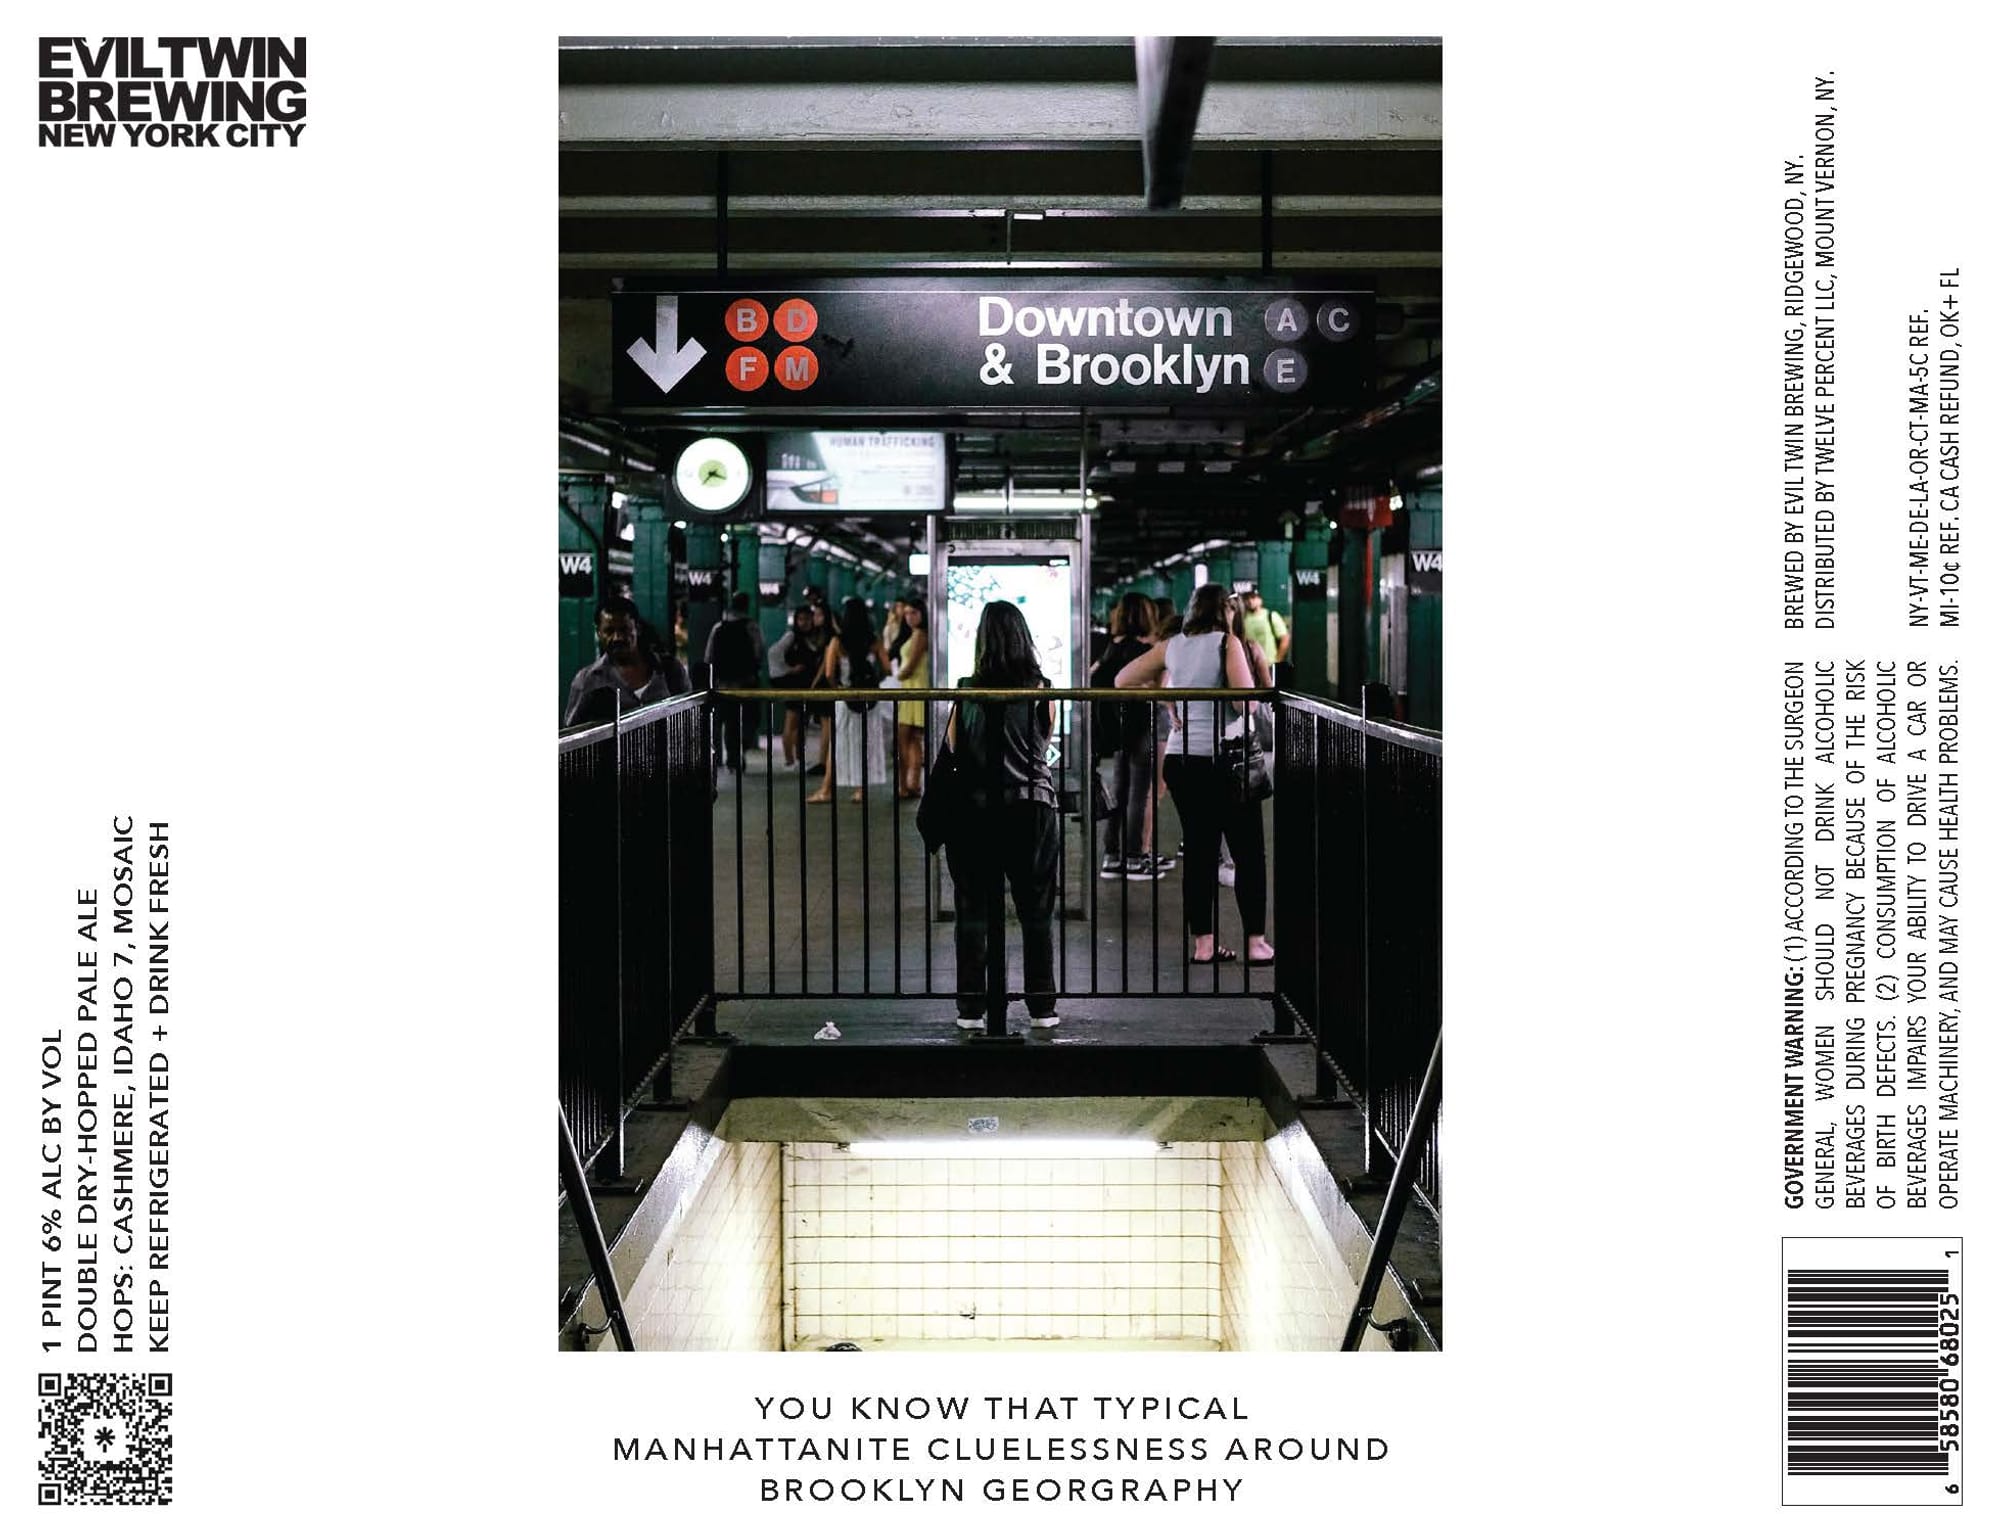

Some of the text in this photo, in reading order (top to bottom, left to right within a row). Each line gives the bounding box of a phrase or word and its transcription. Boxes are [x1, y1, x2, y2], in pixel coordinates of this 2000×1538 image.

[38, 80, 307, 123] BREWING
[38, 123, 307, 148] NEW YORK CITY
[737, 308, 808, 332] B D
[740, 356, 809, 381] F M
[977, 296, 1233, 338] Downtown
[979, 342, 1249, 394] & Brooklyn
[1276, 307, 1350, 333] A C
[1276, 357, 1296, 384] E
[1814, 71, 1838, 629] DISTRIBUTED BY TWELVE PERCENT LLC, MOUNT VERNON, NY.
[830, 436, 935, 448] HUMAN TRAFFICKING
[1784, 155, 1807, 629] BREWED BY EVIL TWIN BREWING, RIDGEWOOD, NY.
[1939, 267, 1963, 627] MI-10¢ REF. CA CASH REFUND, OK+ FL
[1908, 309, 1929, 627] NY-VT-ME-DE-LA-OR-CT-MA-5C REF.
[560, 555, 593, 575] W4
[688, 571, 712, 586] W4
[1296, 570, 1320, 586] W4
[1784, 662, 1807, 1210] GOVERNMENT WARNING: (1) ACCORDING TO THE SURGEON
[1814, 661, 1838, 1210] GENERAL, WOMEN SHOULD NOT DRINK ALCOHOLIC
[1845, 659, 1866, 1209] BEVERAGES DURING PREGNANCY BECAUSE OF THE RISK
[1876, 661, 1900, 1210] OF BIRTH DEFECTS. (2) CONSUMPTION OF ALCOHOLIC
[1906, 661, 1927, 1209] BEVERAGES IMPAIRS YOUR ABILITY TO DRIVE A CAR OR
[1938, 660, 1961, 1210] OPERATE MACHINERY, AND MAY CAUSE HEALTH PROBLEMS.
[77, 888, 98, 1353] DOUBLE DRY-HOPPED PALE ALE
[113, 815, 137, 1353] HOPS: CASHMERE, IDAHO 7, MOSAIC
[149, 822, 169, 1353] KEEP REFRIGERATED + DRINK FRESH
[41, 1029, 63, 1353] 1 PINT 6% ALC BY VOL
[754, 1396, 1248, 1420] YOU KNOW THAT TYPICAL
[1939, 1250, 1960, 1495] 6 58580 68025 1
[614, 1437, 1388, 1461] MANHATTANITE CLUELESSNESS AROUND
[761, 1478, 1243, 1502] BROOKLYN GEORGRAPHY
